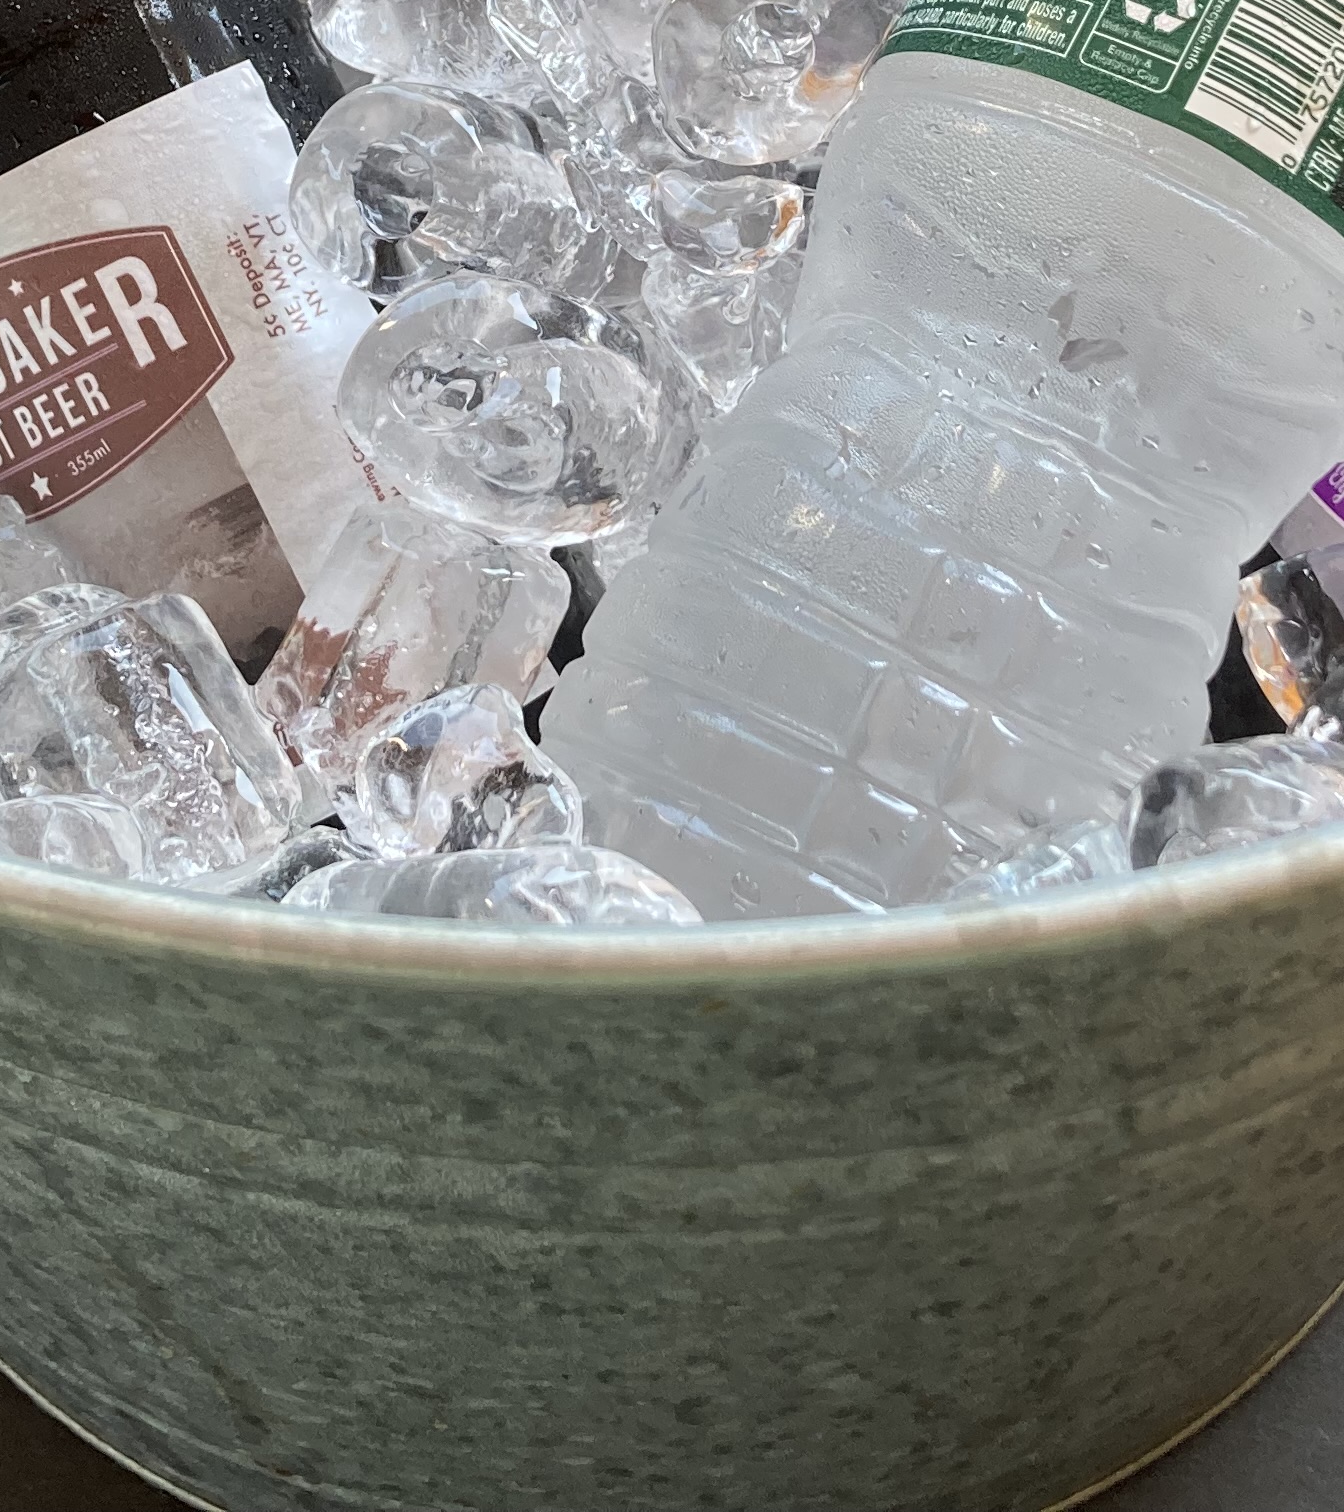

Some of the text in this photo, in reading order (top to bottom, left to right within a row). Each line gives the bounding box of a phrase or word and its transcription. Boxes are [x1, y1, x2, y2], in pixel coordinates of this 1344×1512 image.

[943, 8, 1000, 35] particularly
[998, 15, 1017, 35] for
[1015, 16, 1068, 49] children.
[1028, 0, 1064, 25] poses
[1065, 9, 1078, 25] a
[1107, 44, 1141, 67] Empty
[1281, 153, 1298, 170] 0
[264, 212, 288, 238] CT
[242, 213, 313, 334] ME, MA, VT,
[282, 242, 308, 278] 10¢
[226, 231, 287, 339] 5¢ Deposit:
[12, 371, 112, 450] BEER
[66, 437, 113, 477] 355ml
